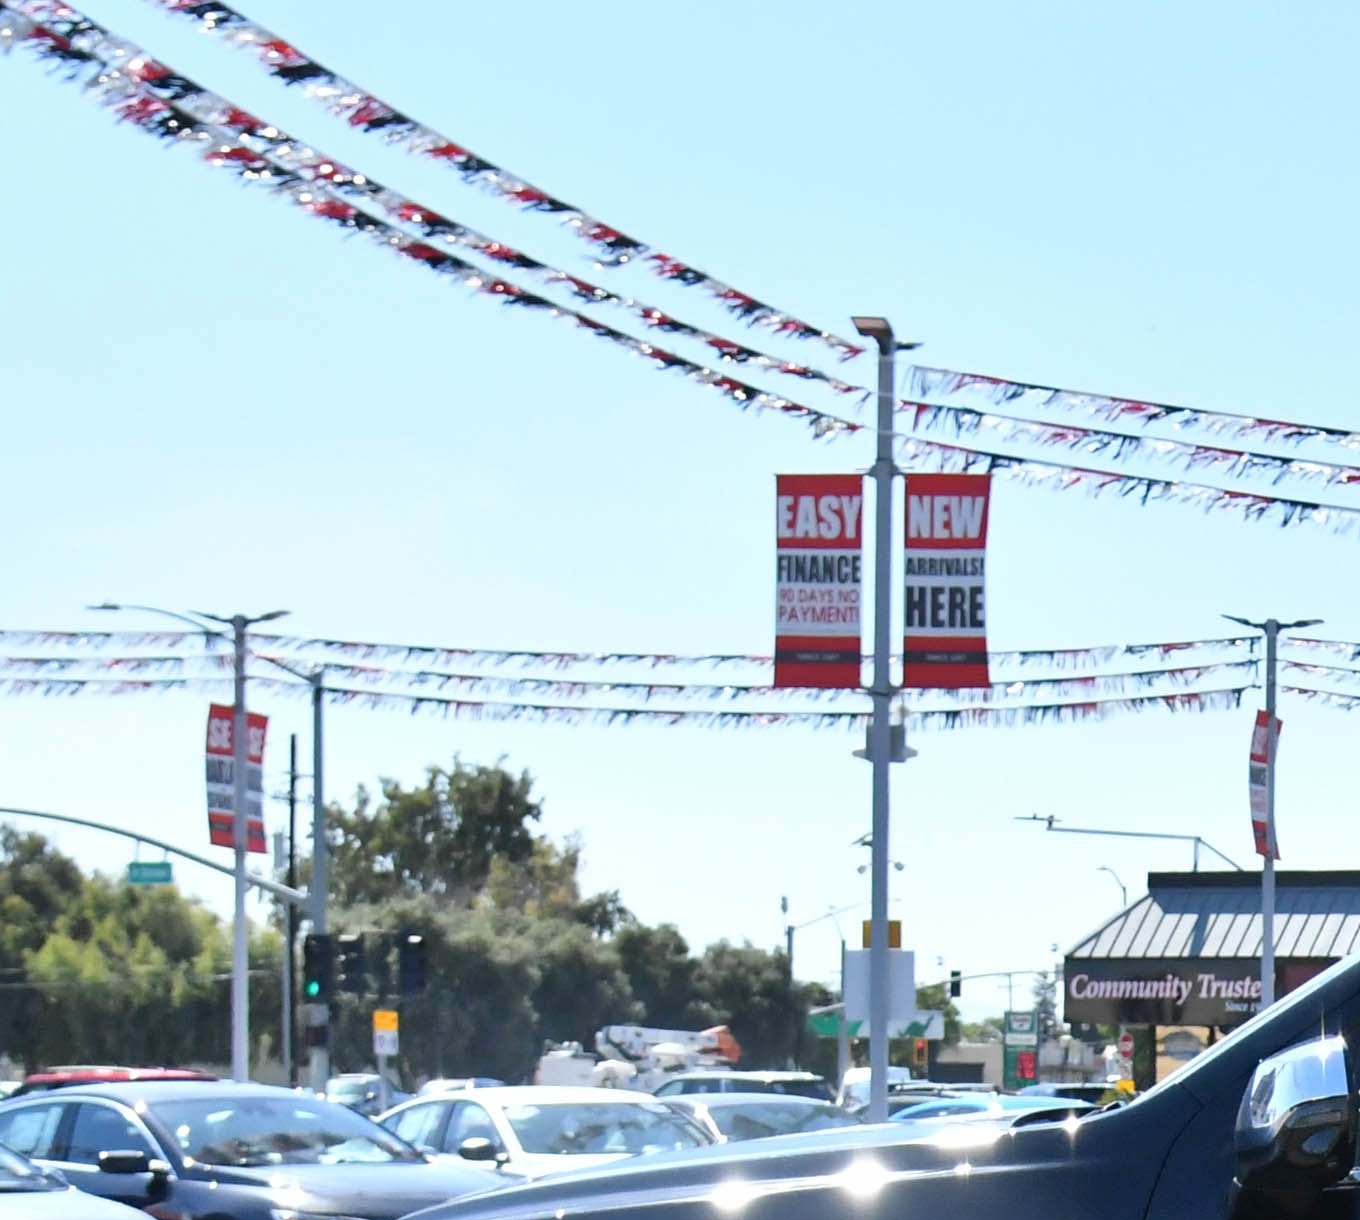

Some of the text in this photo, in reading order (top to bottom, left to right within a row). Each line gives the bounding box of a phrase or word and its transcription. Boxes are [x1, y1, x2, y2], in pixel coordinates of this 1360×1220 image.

[777, 494, 862, 540] EASY
[907, 494, 986, 540] NEW
[777, 555, 861, 584] FINANCE
[905, 556, 985, 577] ARRIVALS!
[798, 587, 834, 604] DAYS
[838, 587, 860, 604] NO
[905, 586, 985, 628] HERE
[1069, 973, 1264, 1006] Community Truste
